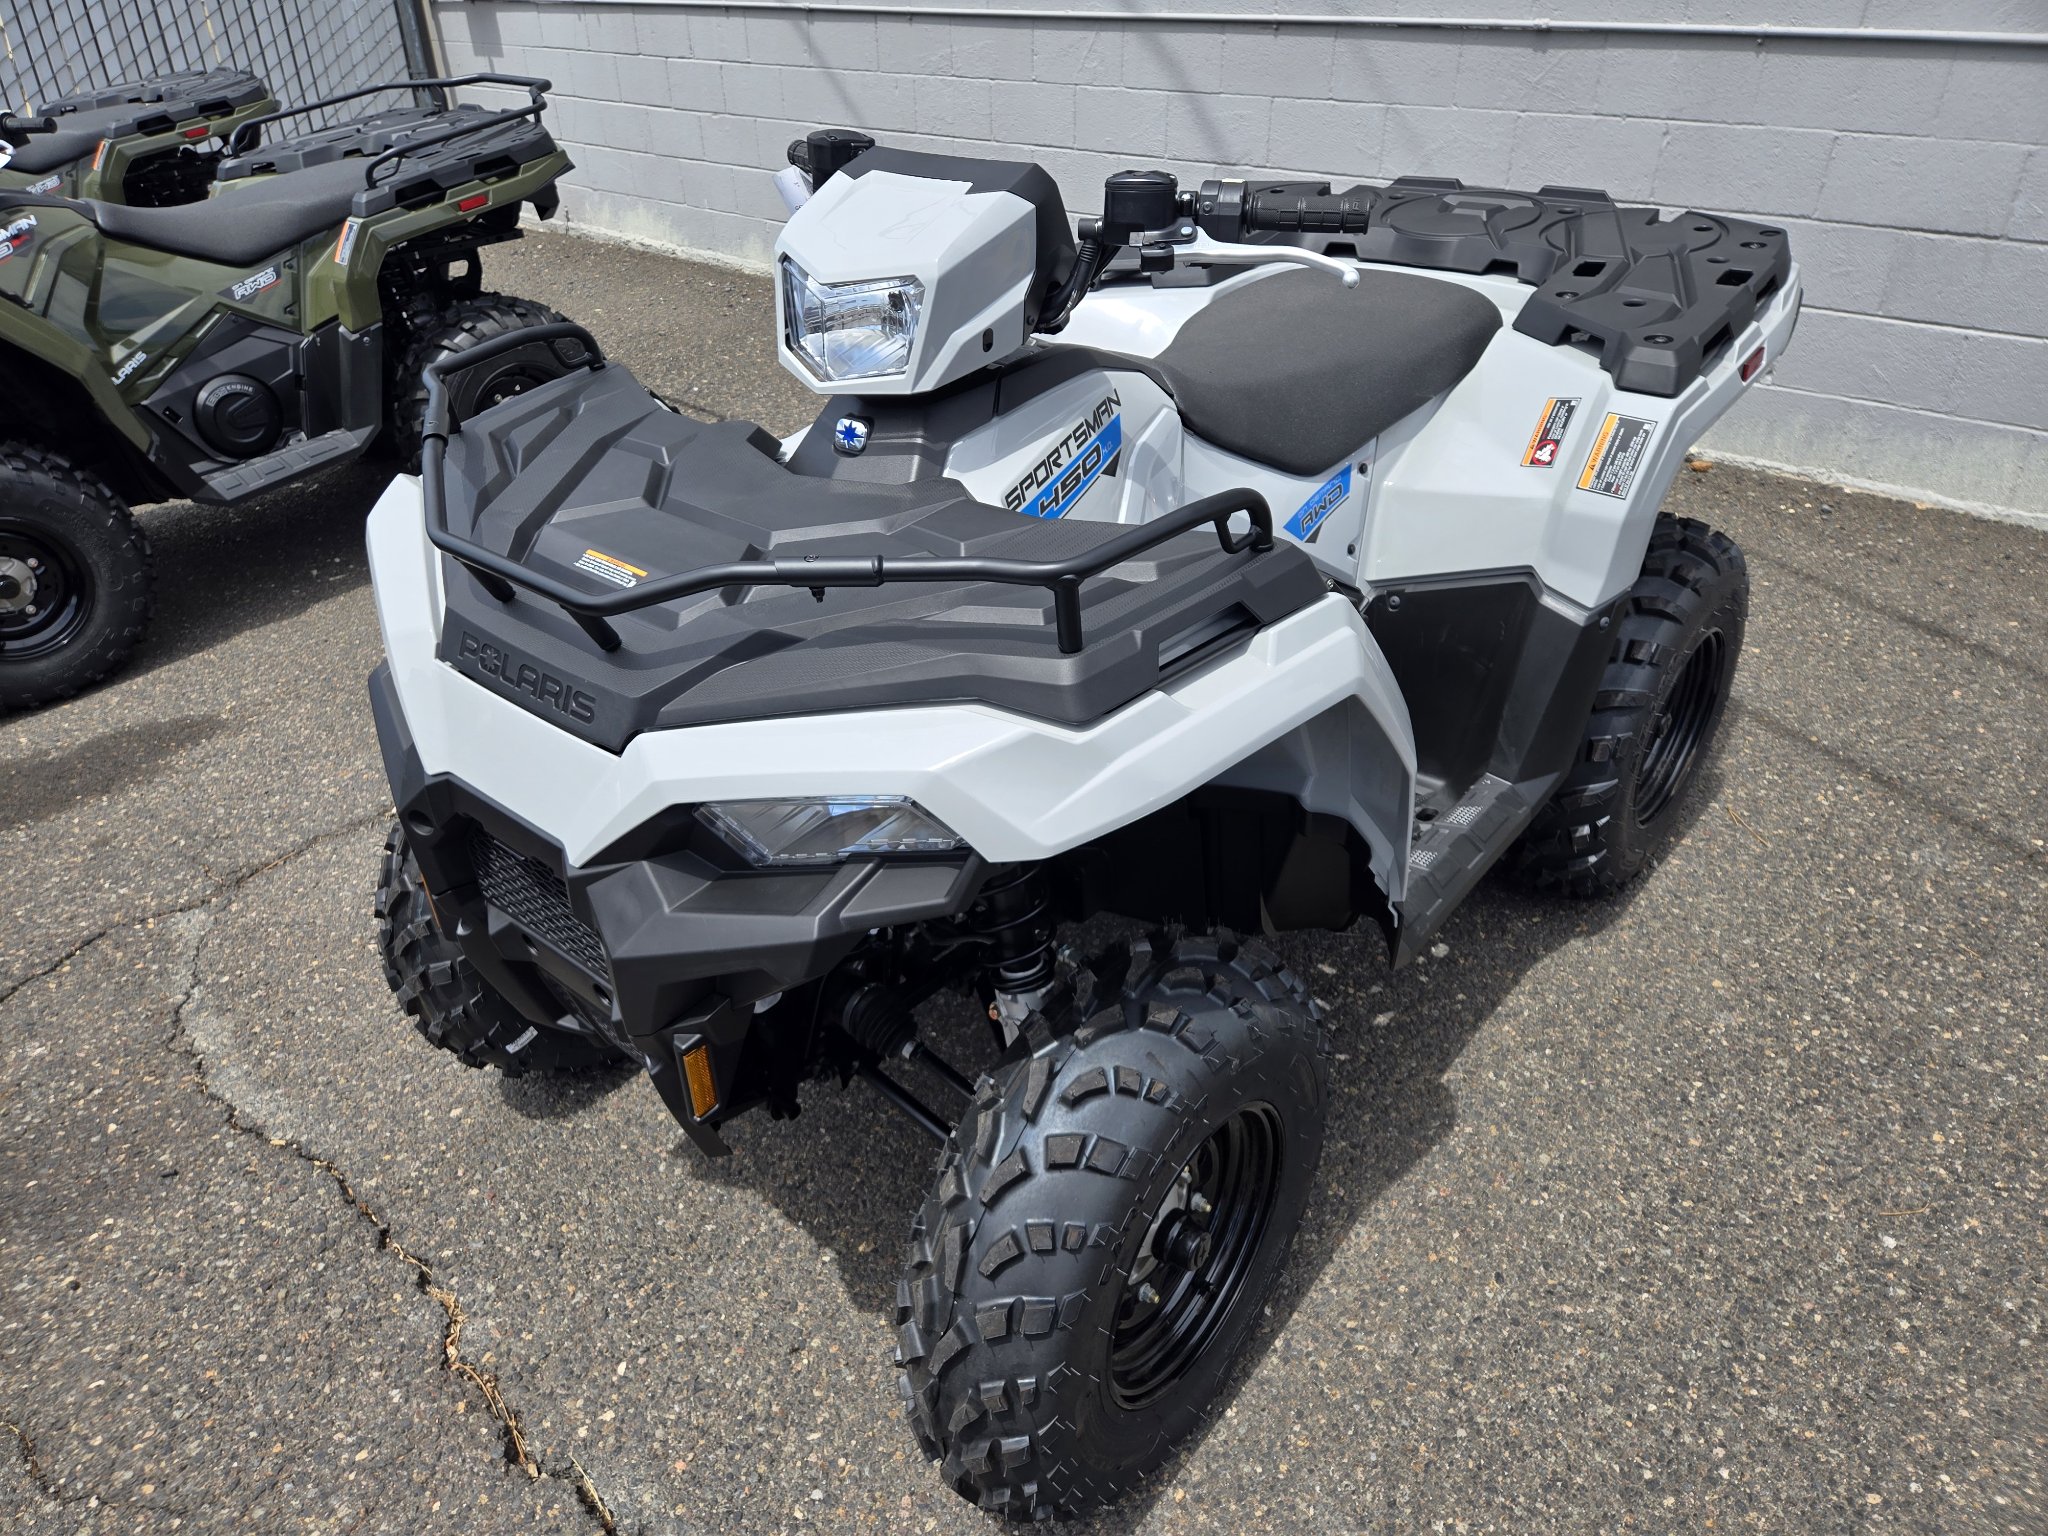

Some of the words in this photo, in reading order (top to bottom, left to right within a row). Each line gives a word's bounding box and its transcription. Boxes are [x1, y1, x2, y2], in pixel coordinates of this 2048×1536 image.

[233, 271, 277, 300] AWD
[111, 350, 147, 386] LARIS
[226, 384, 254, 393] ENGINE
[1004, 388, 1121, 512] SPORTSMAN
[1592, 431, 1610, 465] WARNING
[1039, 442, 1102, 517] 450
[1301, 482, 1344, 535] AWD
[457, 630, 597, 726] POLARIS
